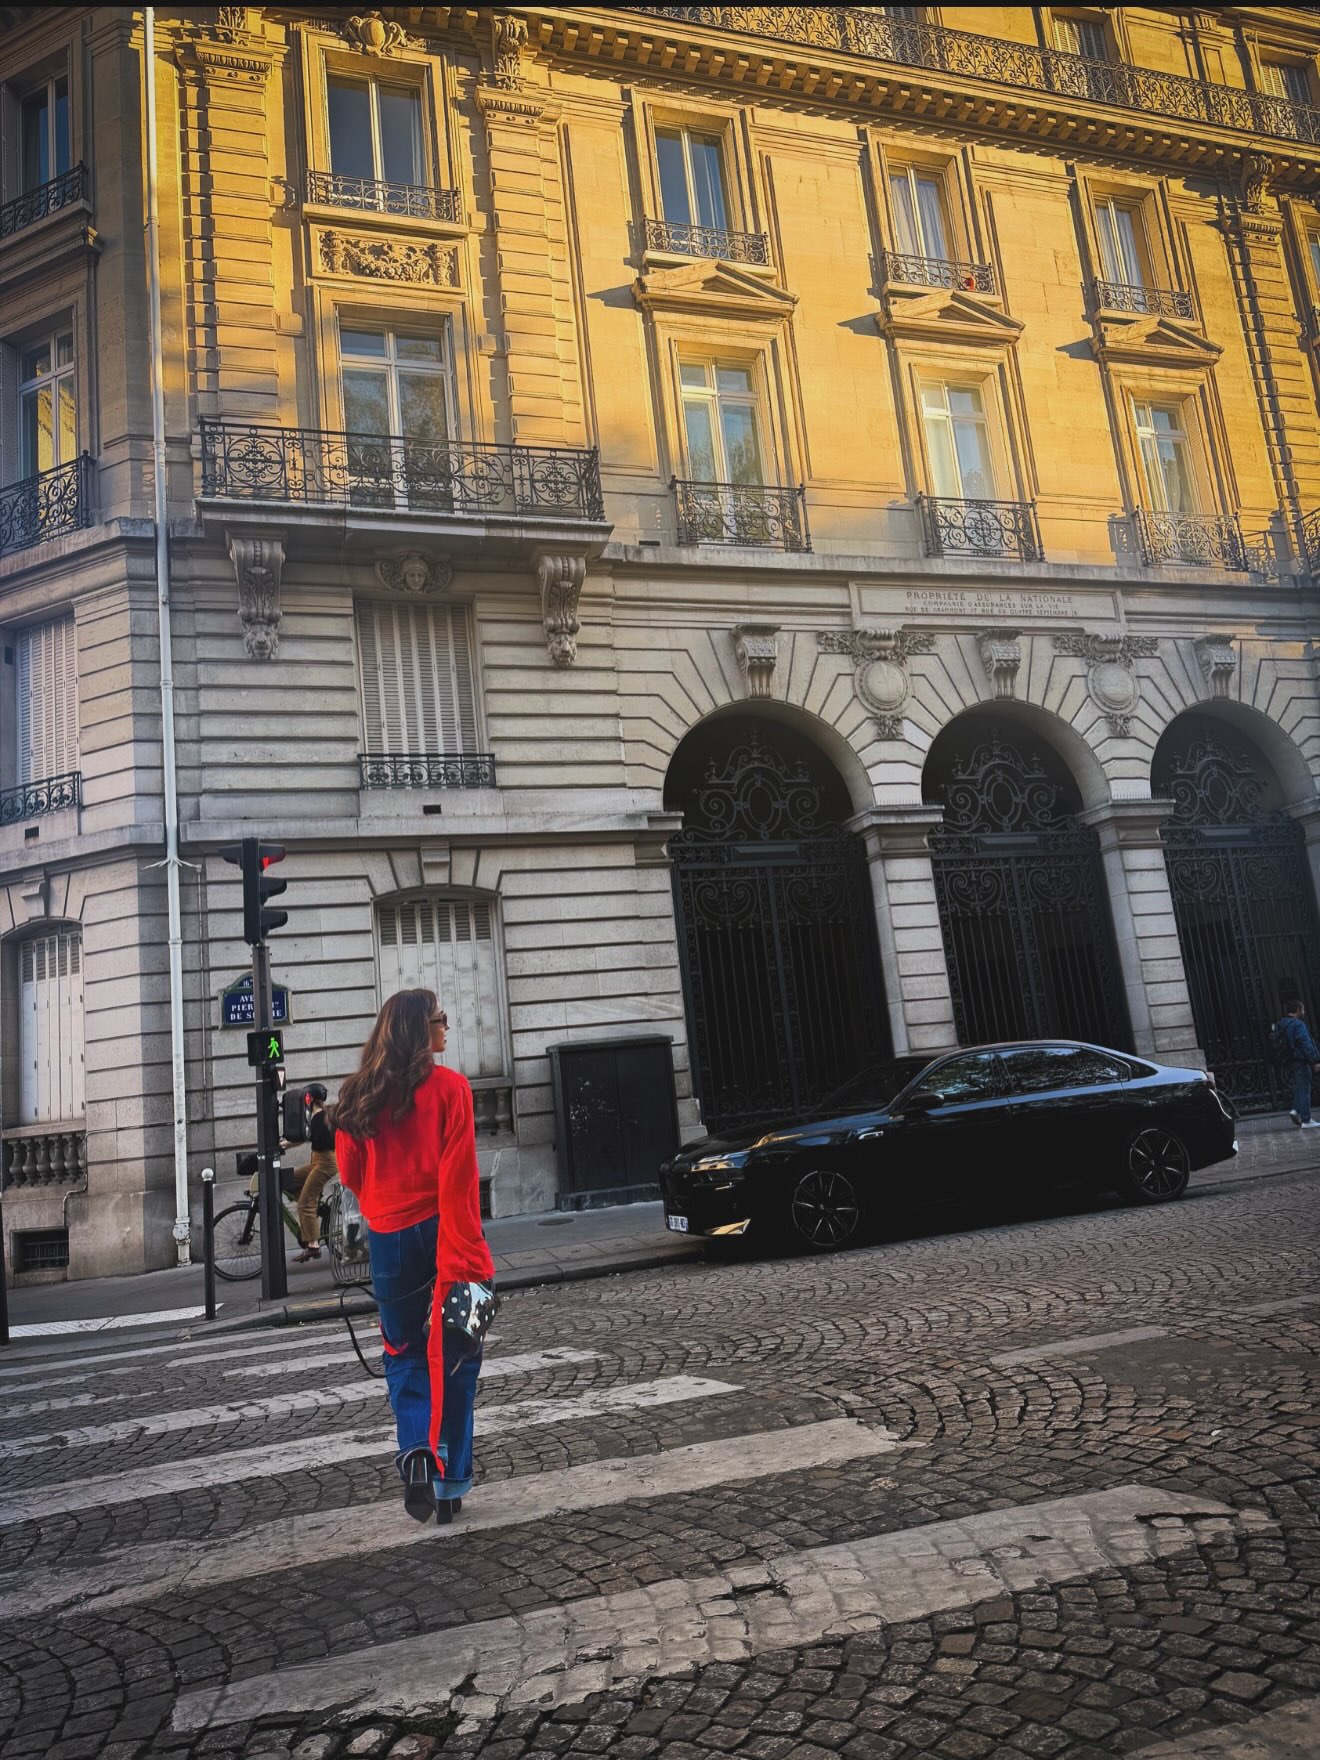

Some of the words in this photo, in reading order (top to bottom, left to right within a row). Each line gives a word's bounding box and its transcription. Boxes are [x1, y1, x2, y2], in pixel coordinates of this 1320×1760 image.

[1000, 592, 1012, 602] LA
[1020, 592, 1073, 604] NATIONALE
[230, 1012, 243, 1021] DE
